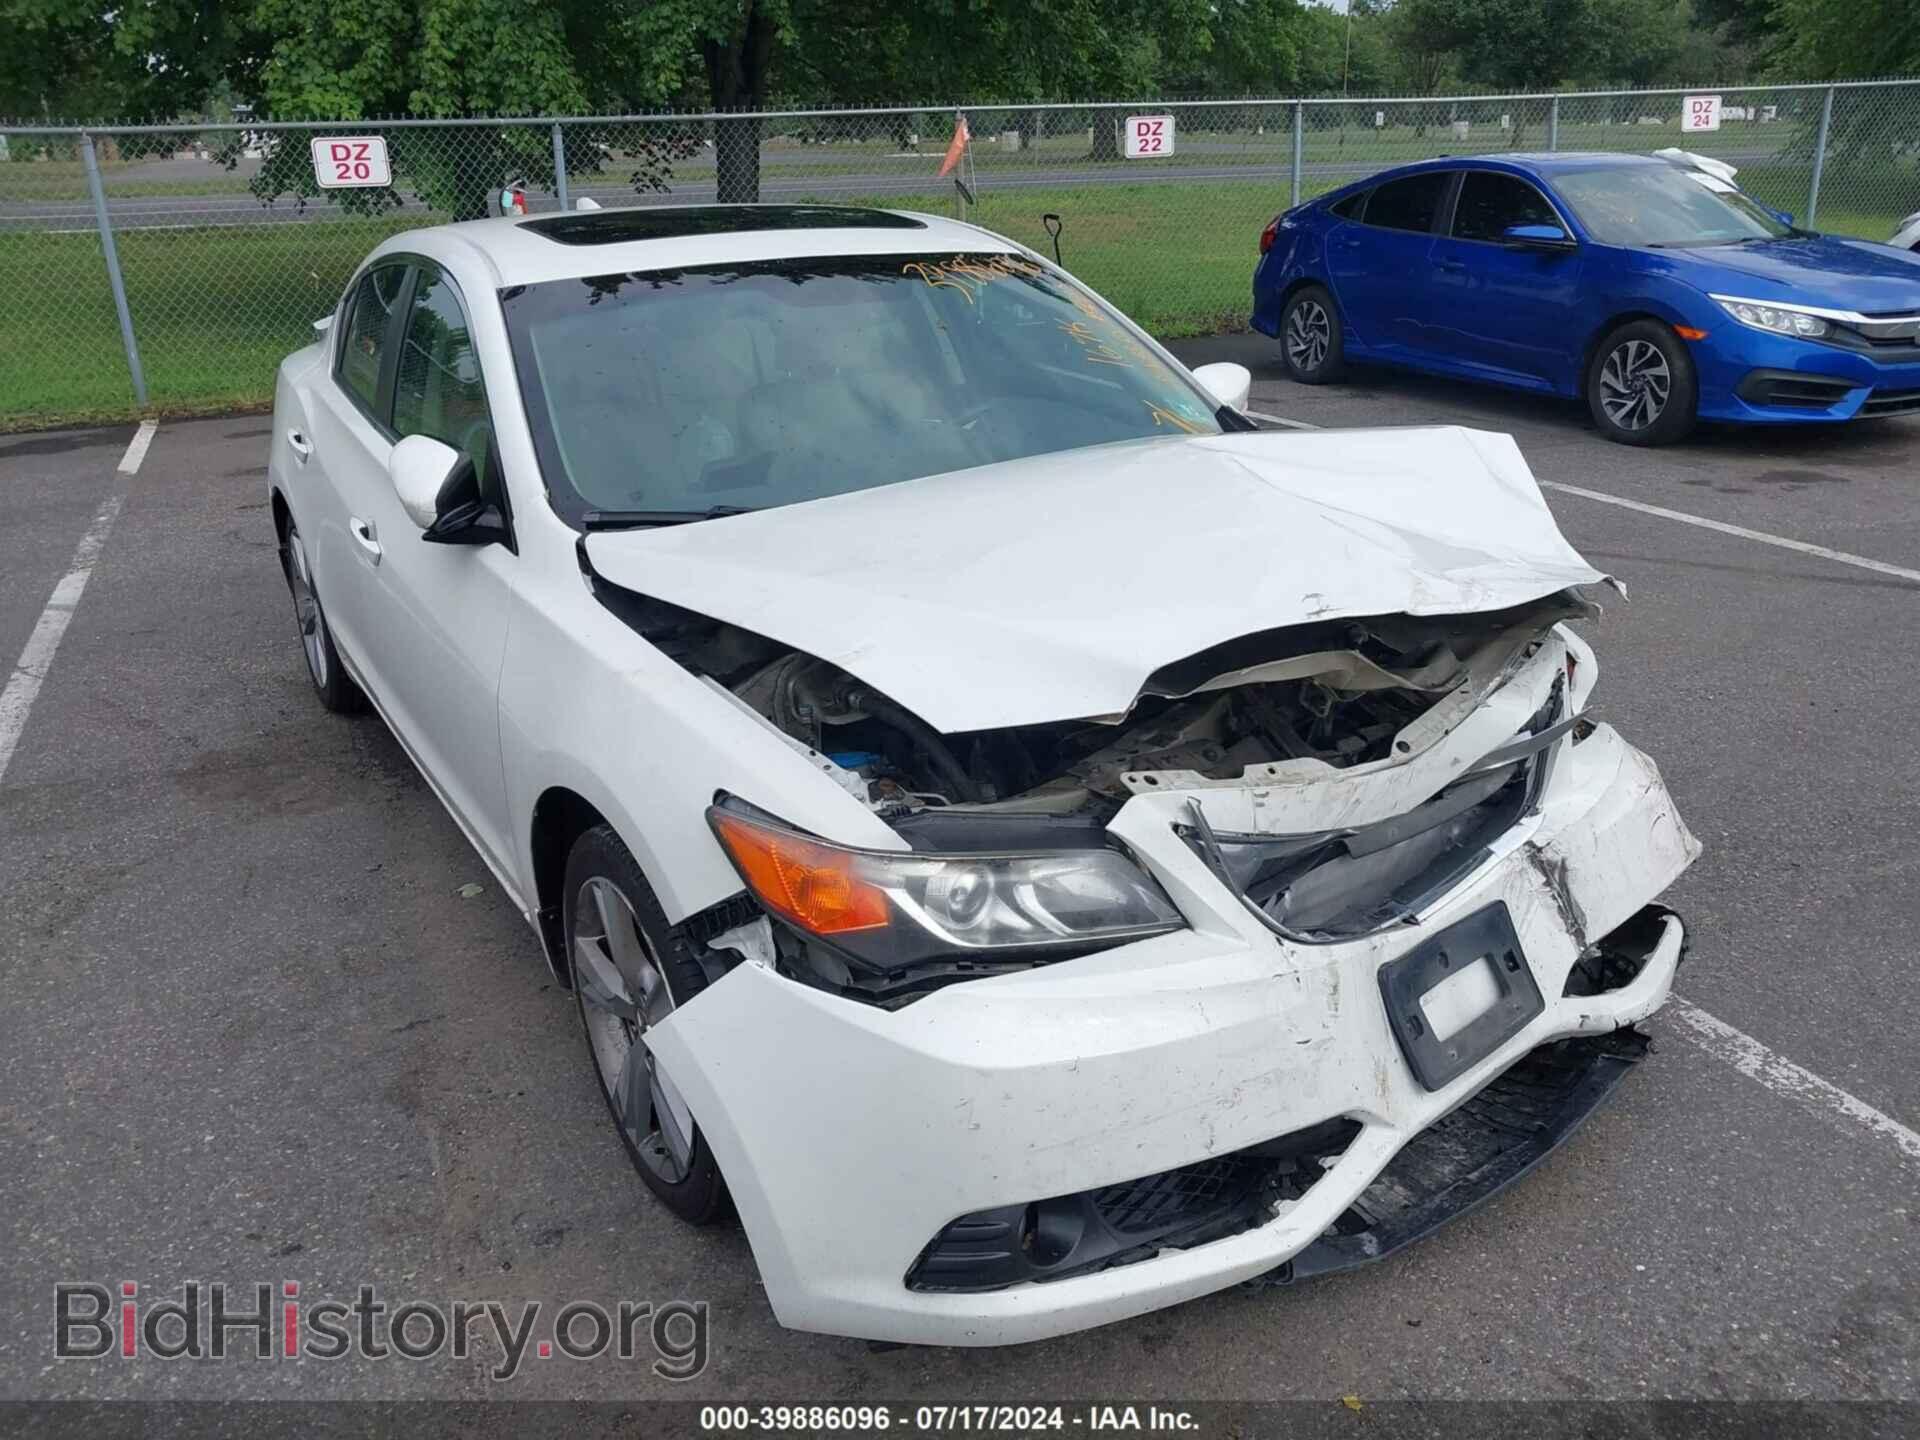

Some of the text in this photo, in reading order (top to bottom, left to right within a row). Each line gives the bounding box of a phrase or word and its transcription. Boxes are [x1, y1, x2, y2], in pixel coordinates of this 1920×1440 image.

[1692, 101, 1713, 113] DZ
[1693, 115, 1710, 127] 24
[1137, 121, 1164, 137] DZ
[330, 143, 372, 161] DZ
[1138, 138, 1162, 152] 22
[335, 162, 370, 180] 20
